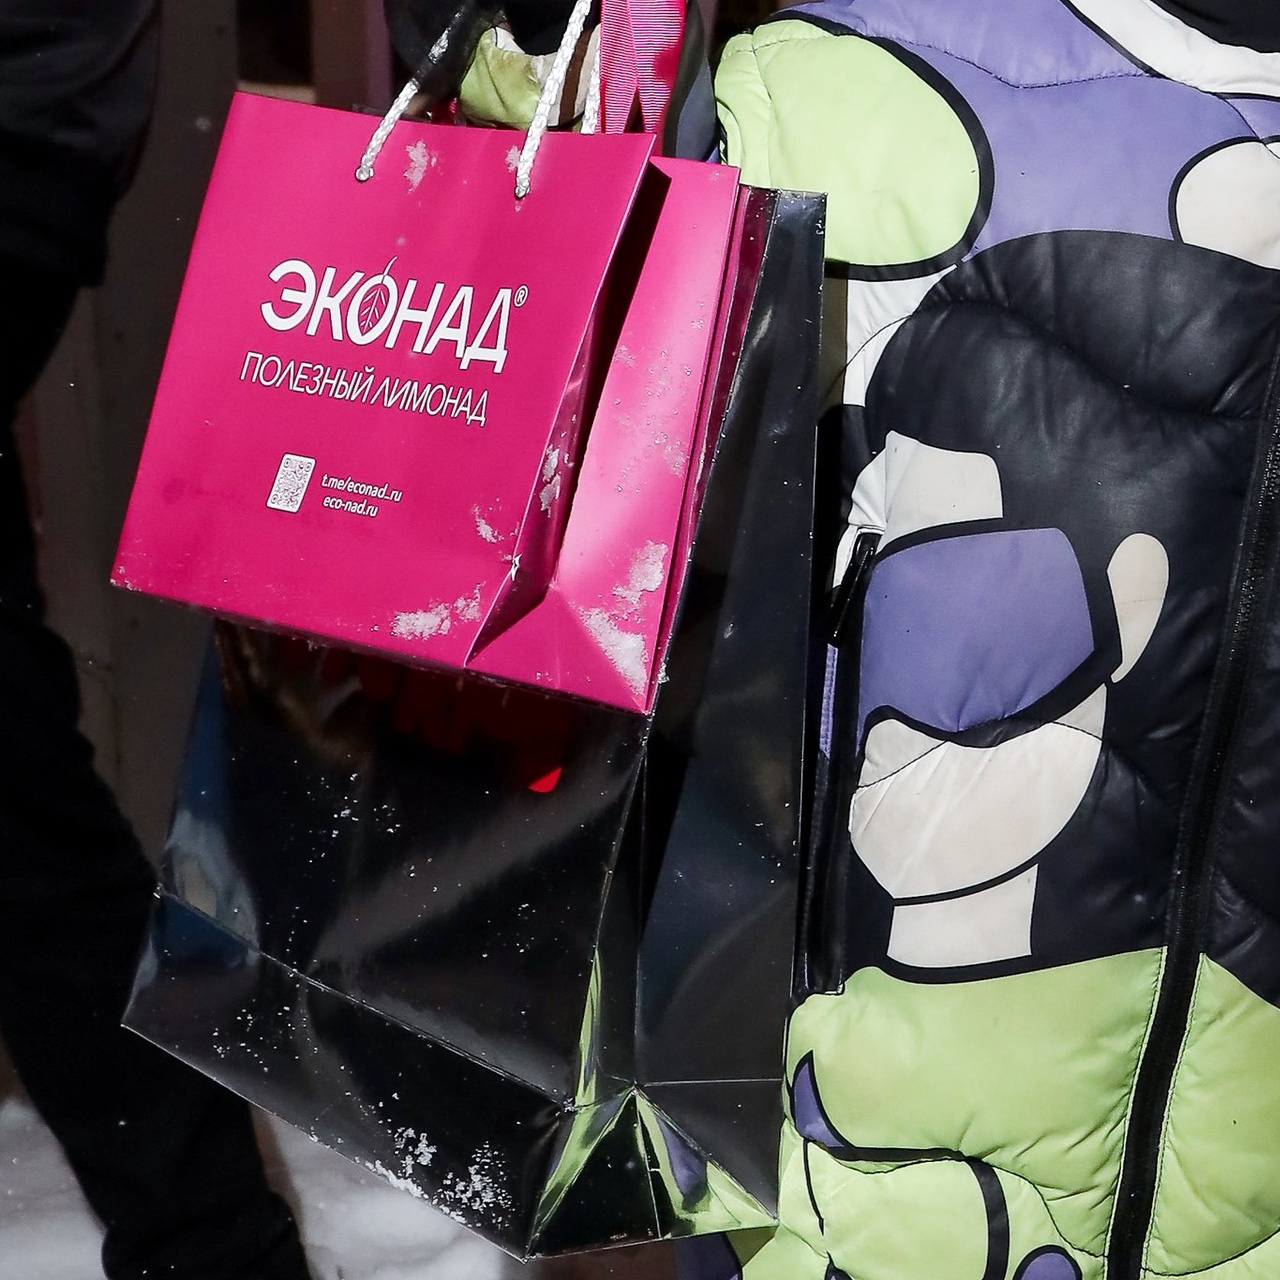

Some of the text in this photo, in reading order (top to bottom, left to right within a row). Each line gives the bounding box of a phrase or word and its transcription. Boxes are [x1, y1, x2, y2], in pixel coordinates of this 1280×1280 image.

[240, 351, 488, 426] ПОЛЕЗНЫЙ ЛИМОНАД
[321, 473, 402, 502] t.me/econad_ru
[323, 496, 378, 517] eco-nad.ru
